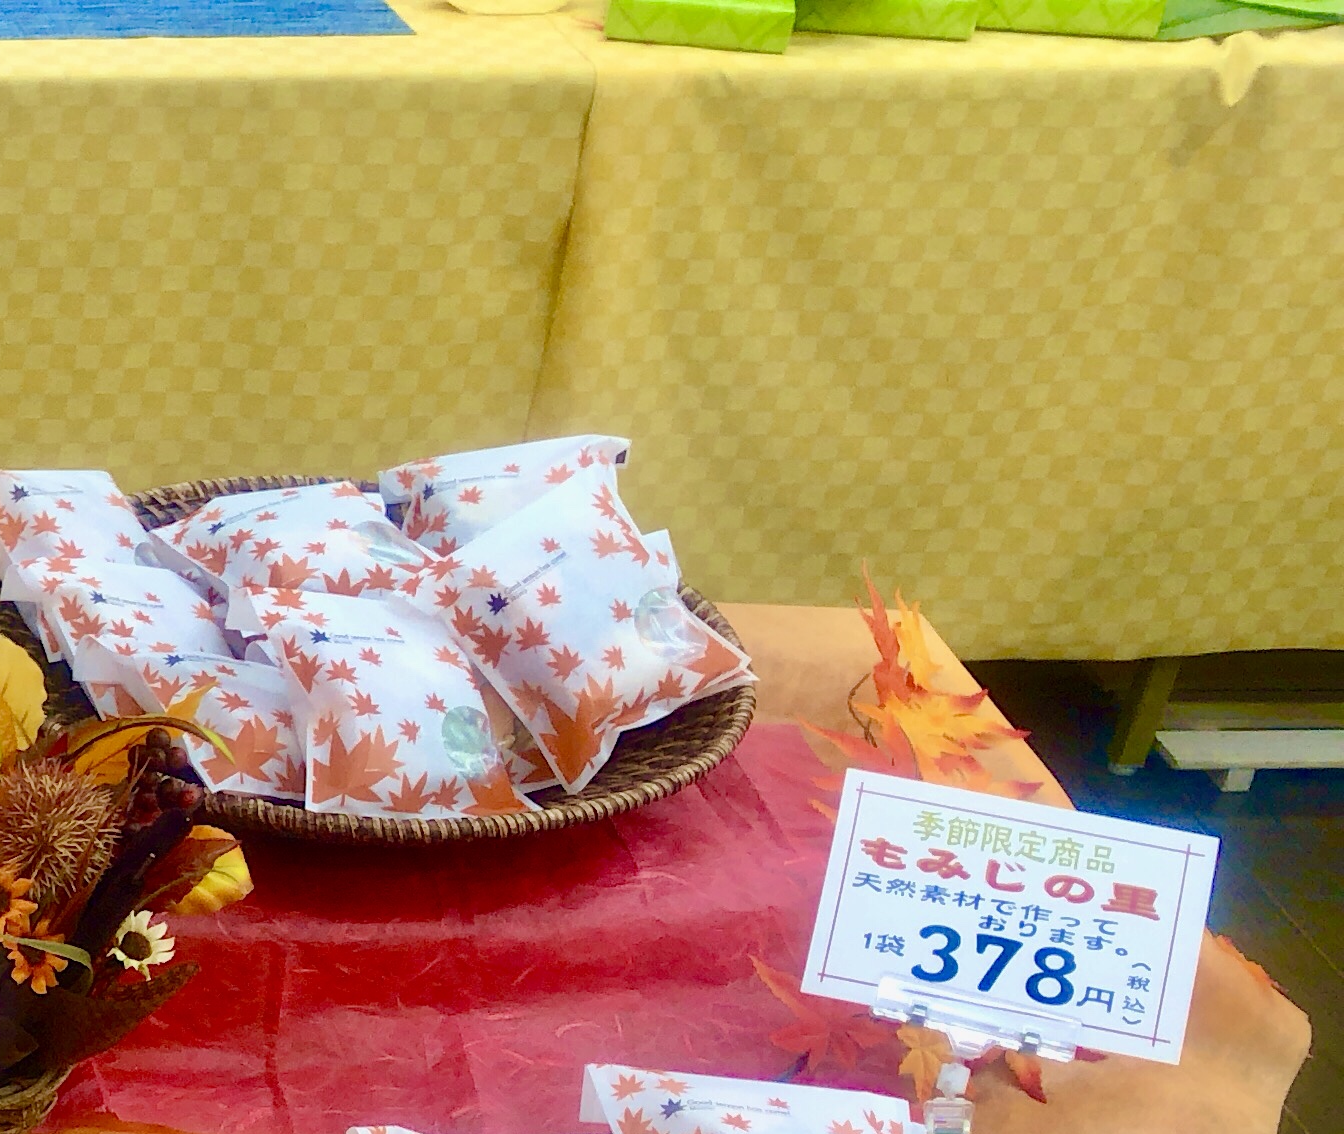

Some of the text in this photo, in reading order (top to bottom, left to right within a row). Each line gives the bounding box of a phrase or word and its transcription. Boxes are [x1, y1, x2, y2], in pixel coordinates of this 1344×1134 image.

[912, 810, 1116, 874] 季節限定商品
[852, 872, 1120, 936] 天然素材で作って
[859, 836, 1161, 921] もみじの里
[863, 932, 906, 957] 1袋
[979, 914, 1129, 958] おります。
